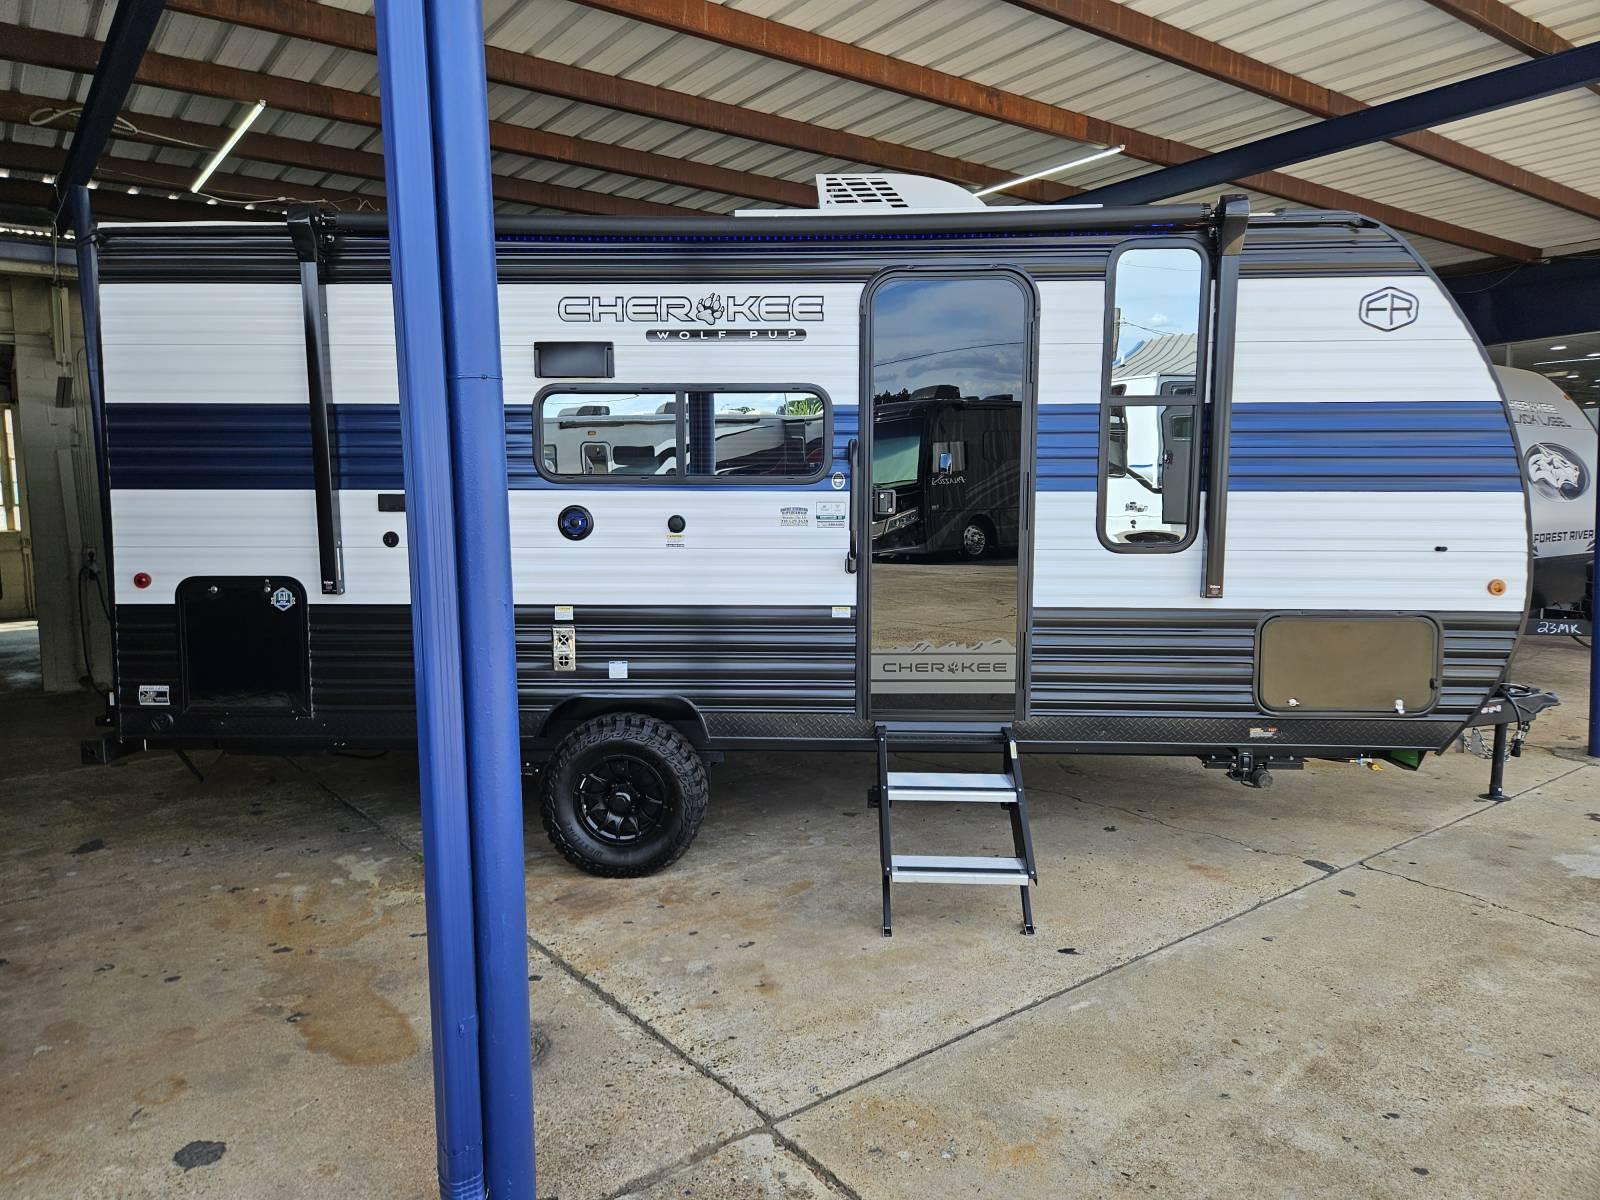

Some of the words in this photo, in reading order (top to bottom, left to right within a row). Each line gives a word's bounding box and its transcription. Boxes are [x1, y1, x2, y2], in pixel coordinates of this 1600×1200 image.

[655, 330, 728, 341] WOLF
[749, 329, 799, 340] PUP
[1533, 531, 1568, 544] FOREST
[1569, 529, 1595, 541] RIVER
